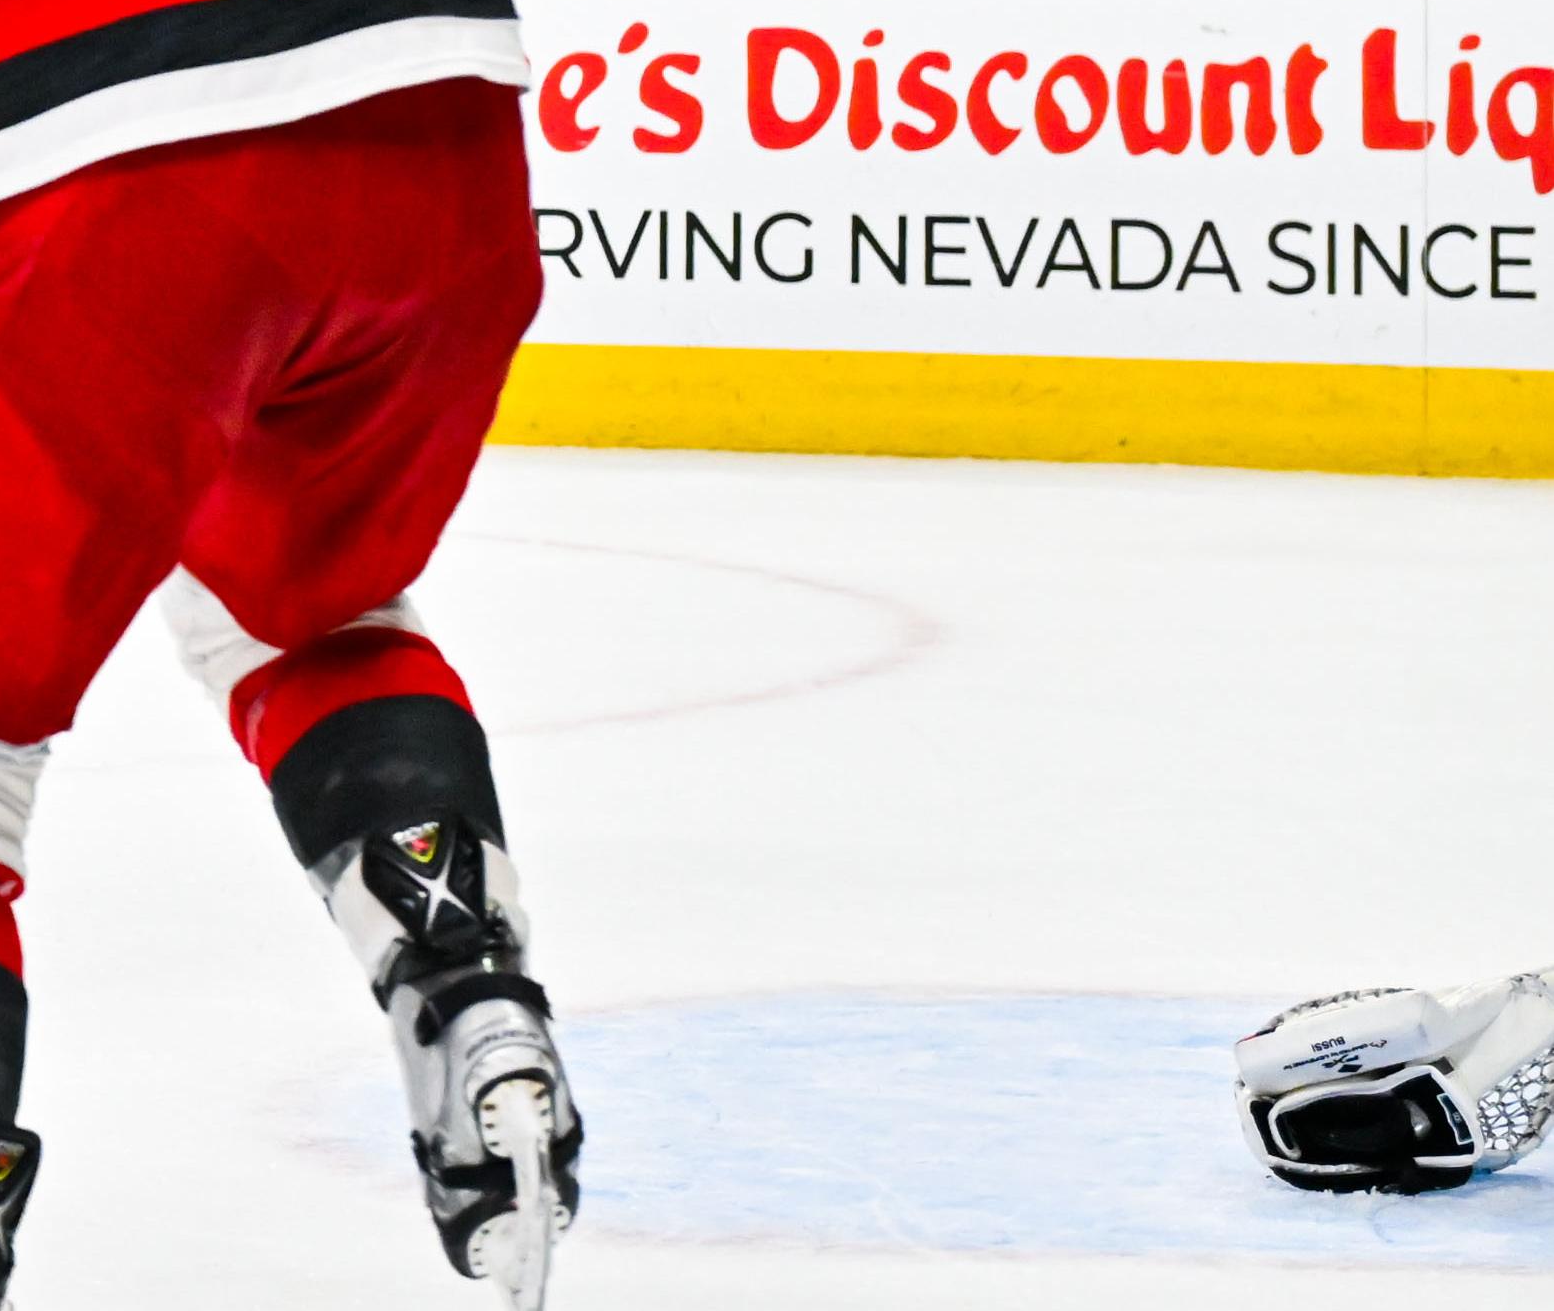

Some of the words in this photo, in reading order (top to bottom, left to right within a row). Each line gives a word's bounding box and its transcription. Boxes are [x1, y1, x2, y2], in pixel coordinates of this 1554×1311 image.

[526, 21, 704, 153] e's
[746, 26, 1330, 156] Discount
[532, 207, 815, 284] RVING
[850, 214, 1242, 294] NEVADA
[1266, 221, 1538, 300] SINCE
[1310, 1035, 1347, 1053] BUSSI
